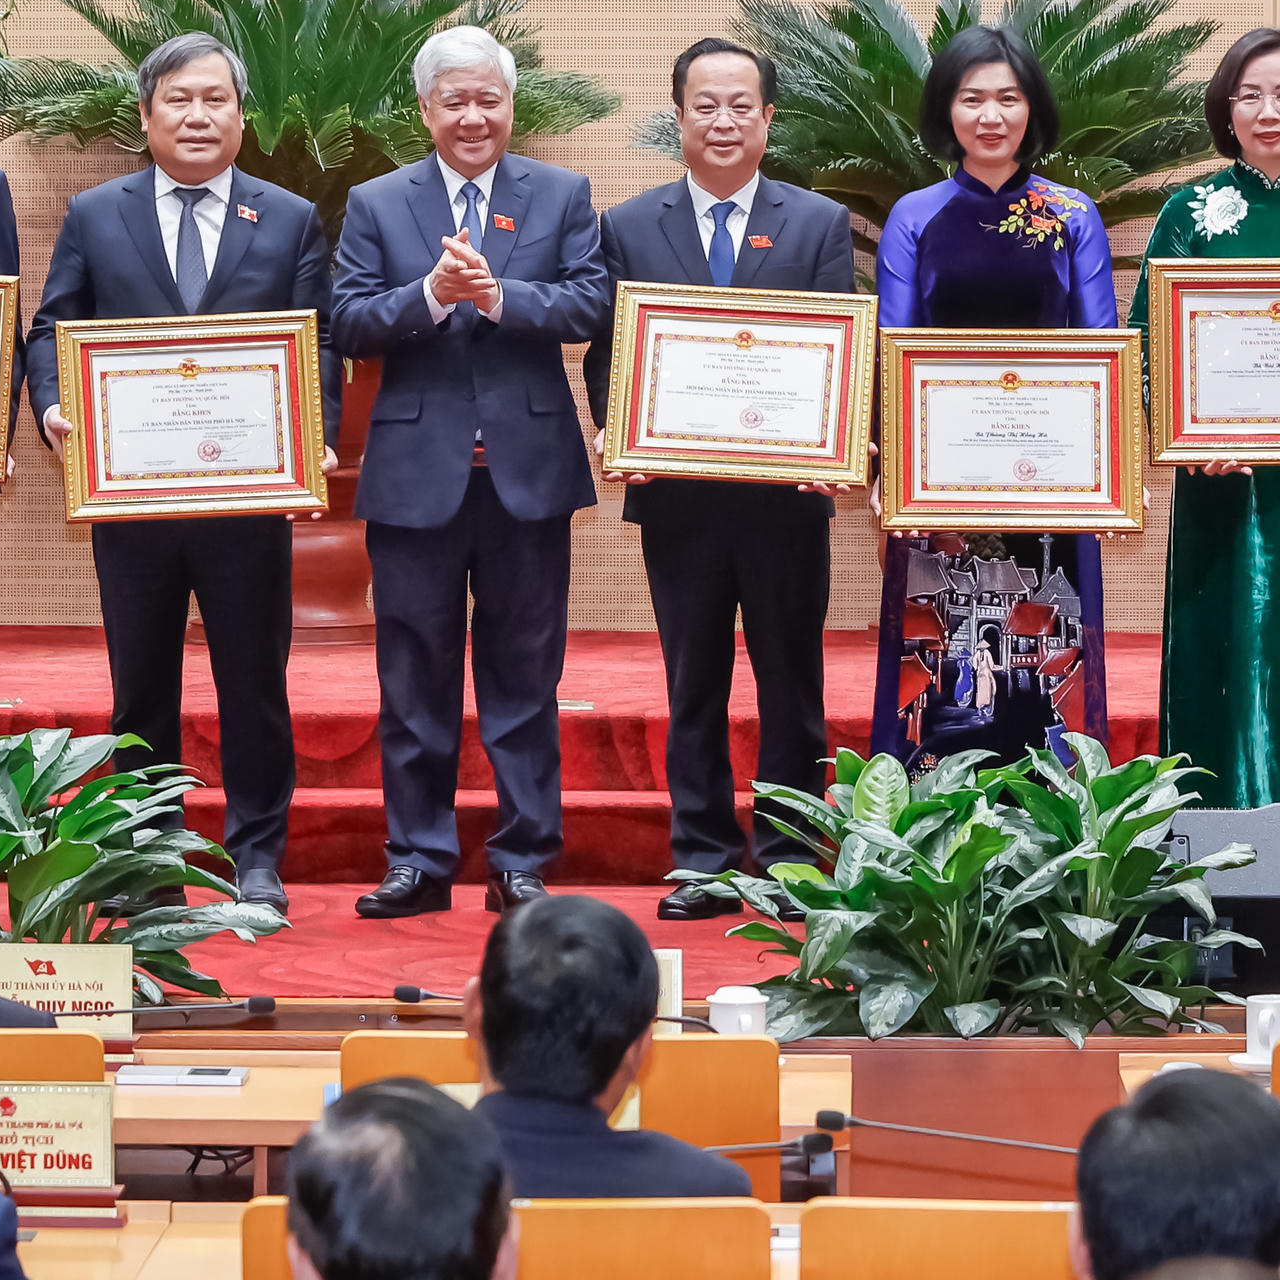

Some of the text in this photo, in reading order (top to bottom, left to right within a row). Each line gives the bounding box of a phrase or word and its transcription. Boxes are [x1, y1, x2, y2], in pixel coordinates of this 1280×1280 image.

[14, 980, 50, 991] THÀNH
[52, 979, 66, 991] ỦY
[68, 980, 82, 991] HÀ
[84, 980, 104, 992] NỘI
[0, 1149, 38, 1174] VIỆT
[43, 1150, 92, 1170] DŨNG
